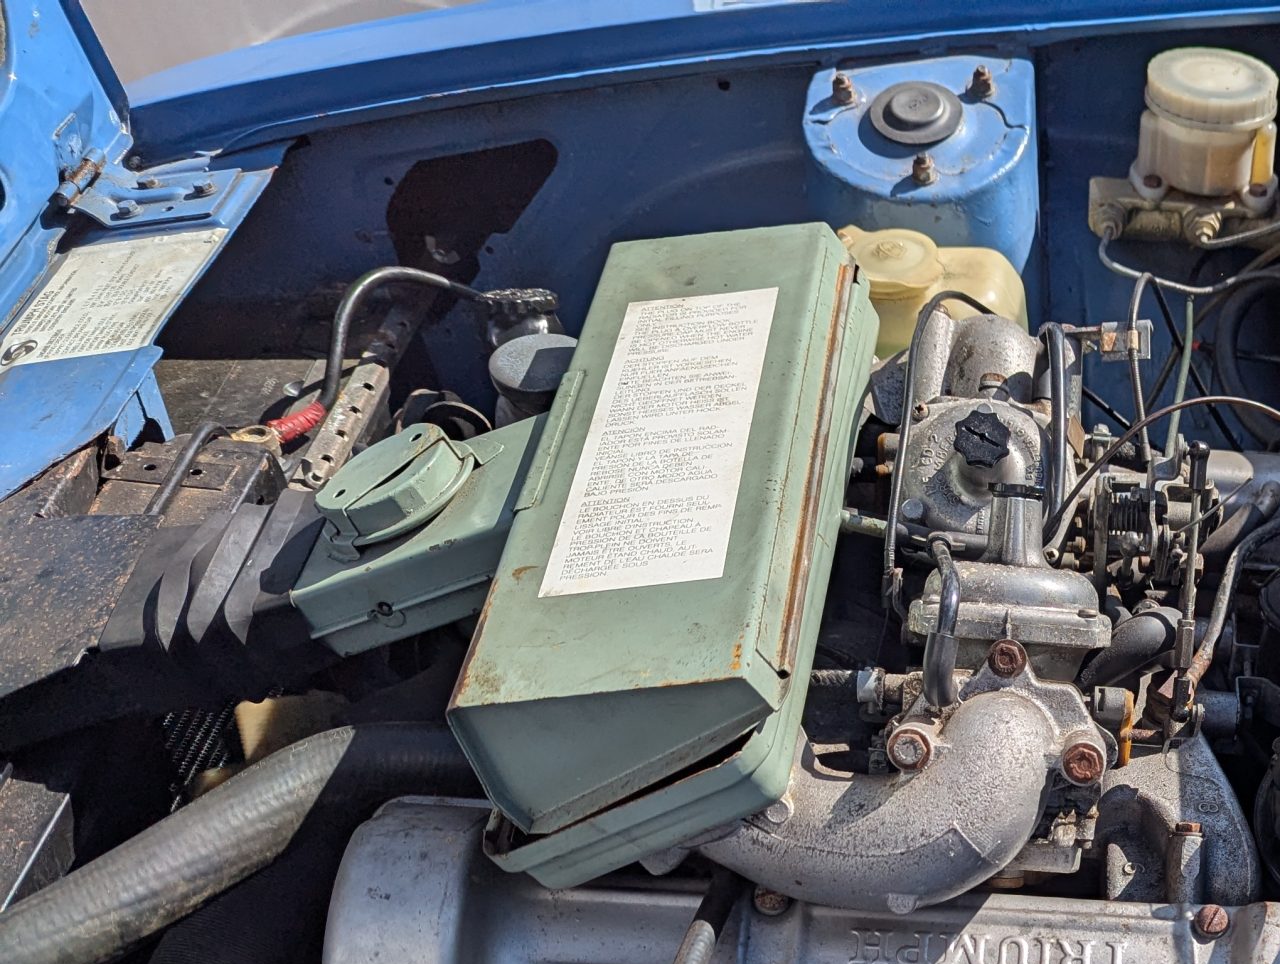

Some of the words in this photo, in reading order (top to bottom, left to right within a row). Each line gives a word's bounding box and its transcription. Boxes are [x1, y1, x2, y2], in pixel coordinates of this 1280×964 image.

[641, 303, 684, 311] ATTENTION
[580, 496, 630, 507] ATTENTION
[592, 502, 639, 511] BOUCHON
[656, 496, 693, 504] DESSUS
[564, 554, 604, 563] MOTEUR
[621, 560, 649, 568] SOUS
